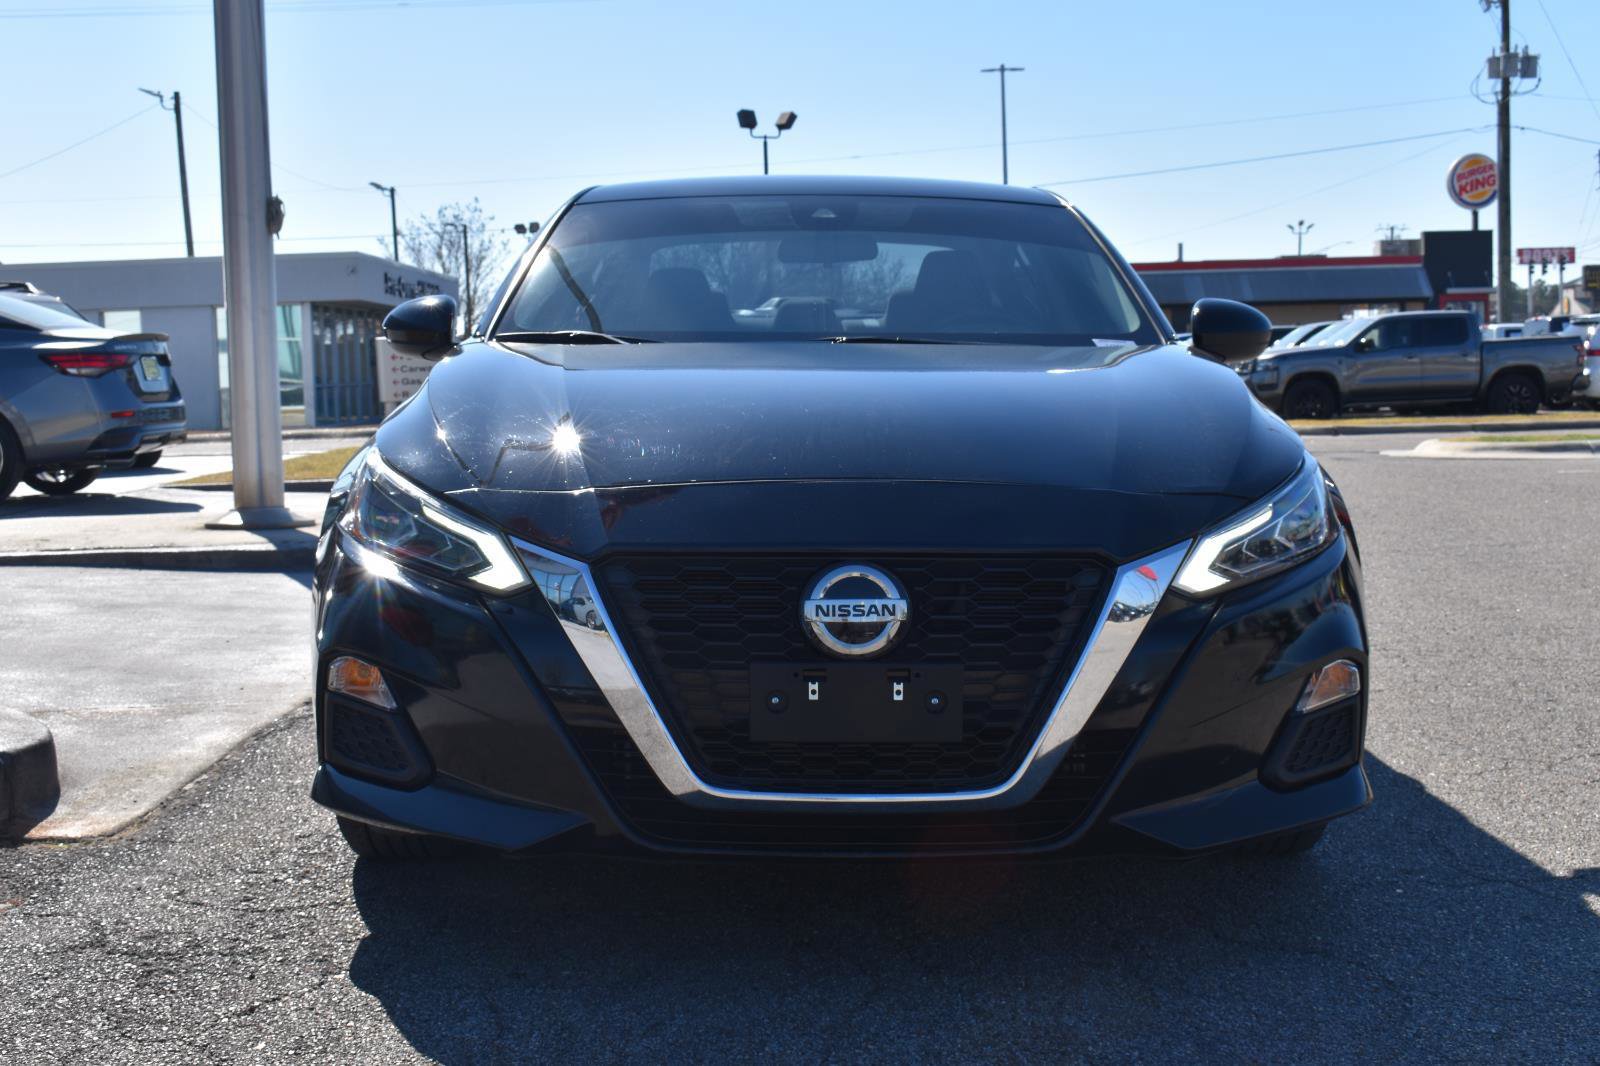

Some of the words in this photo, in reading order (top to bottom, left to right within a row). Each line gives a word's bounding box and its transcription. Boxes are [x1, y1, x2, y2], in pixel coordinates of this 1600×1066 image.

[1456, 163, 1494, 182] BURGER
[1459, 174, 1496, 197] KING
[815, 604, 896, 617] NISSAN
